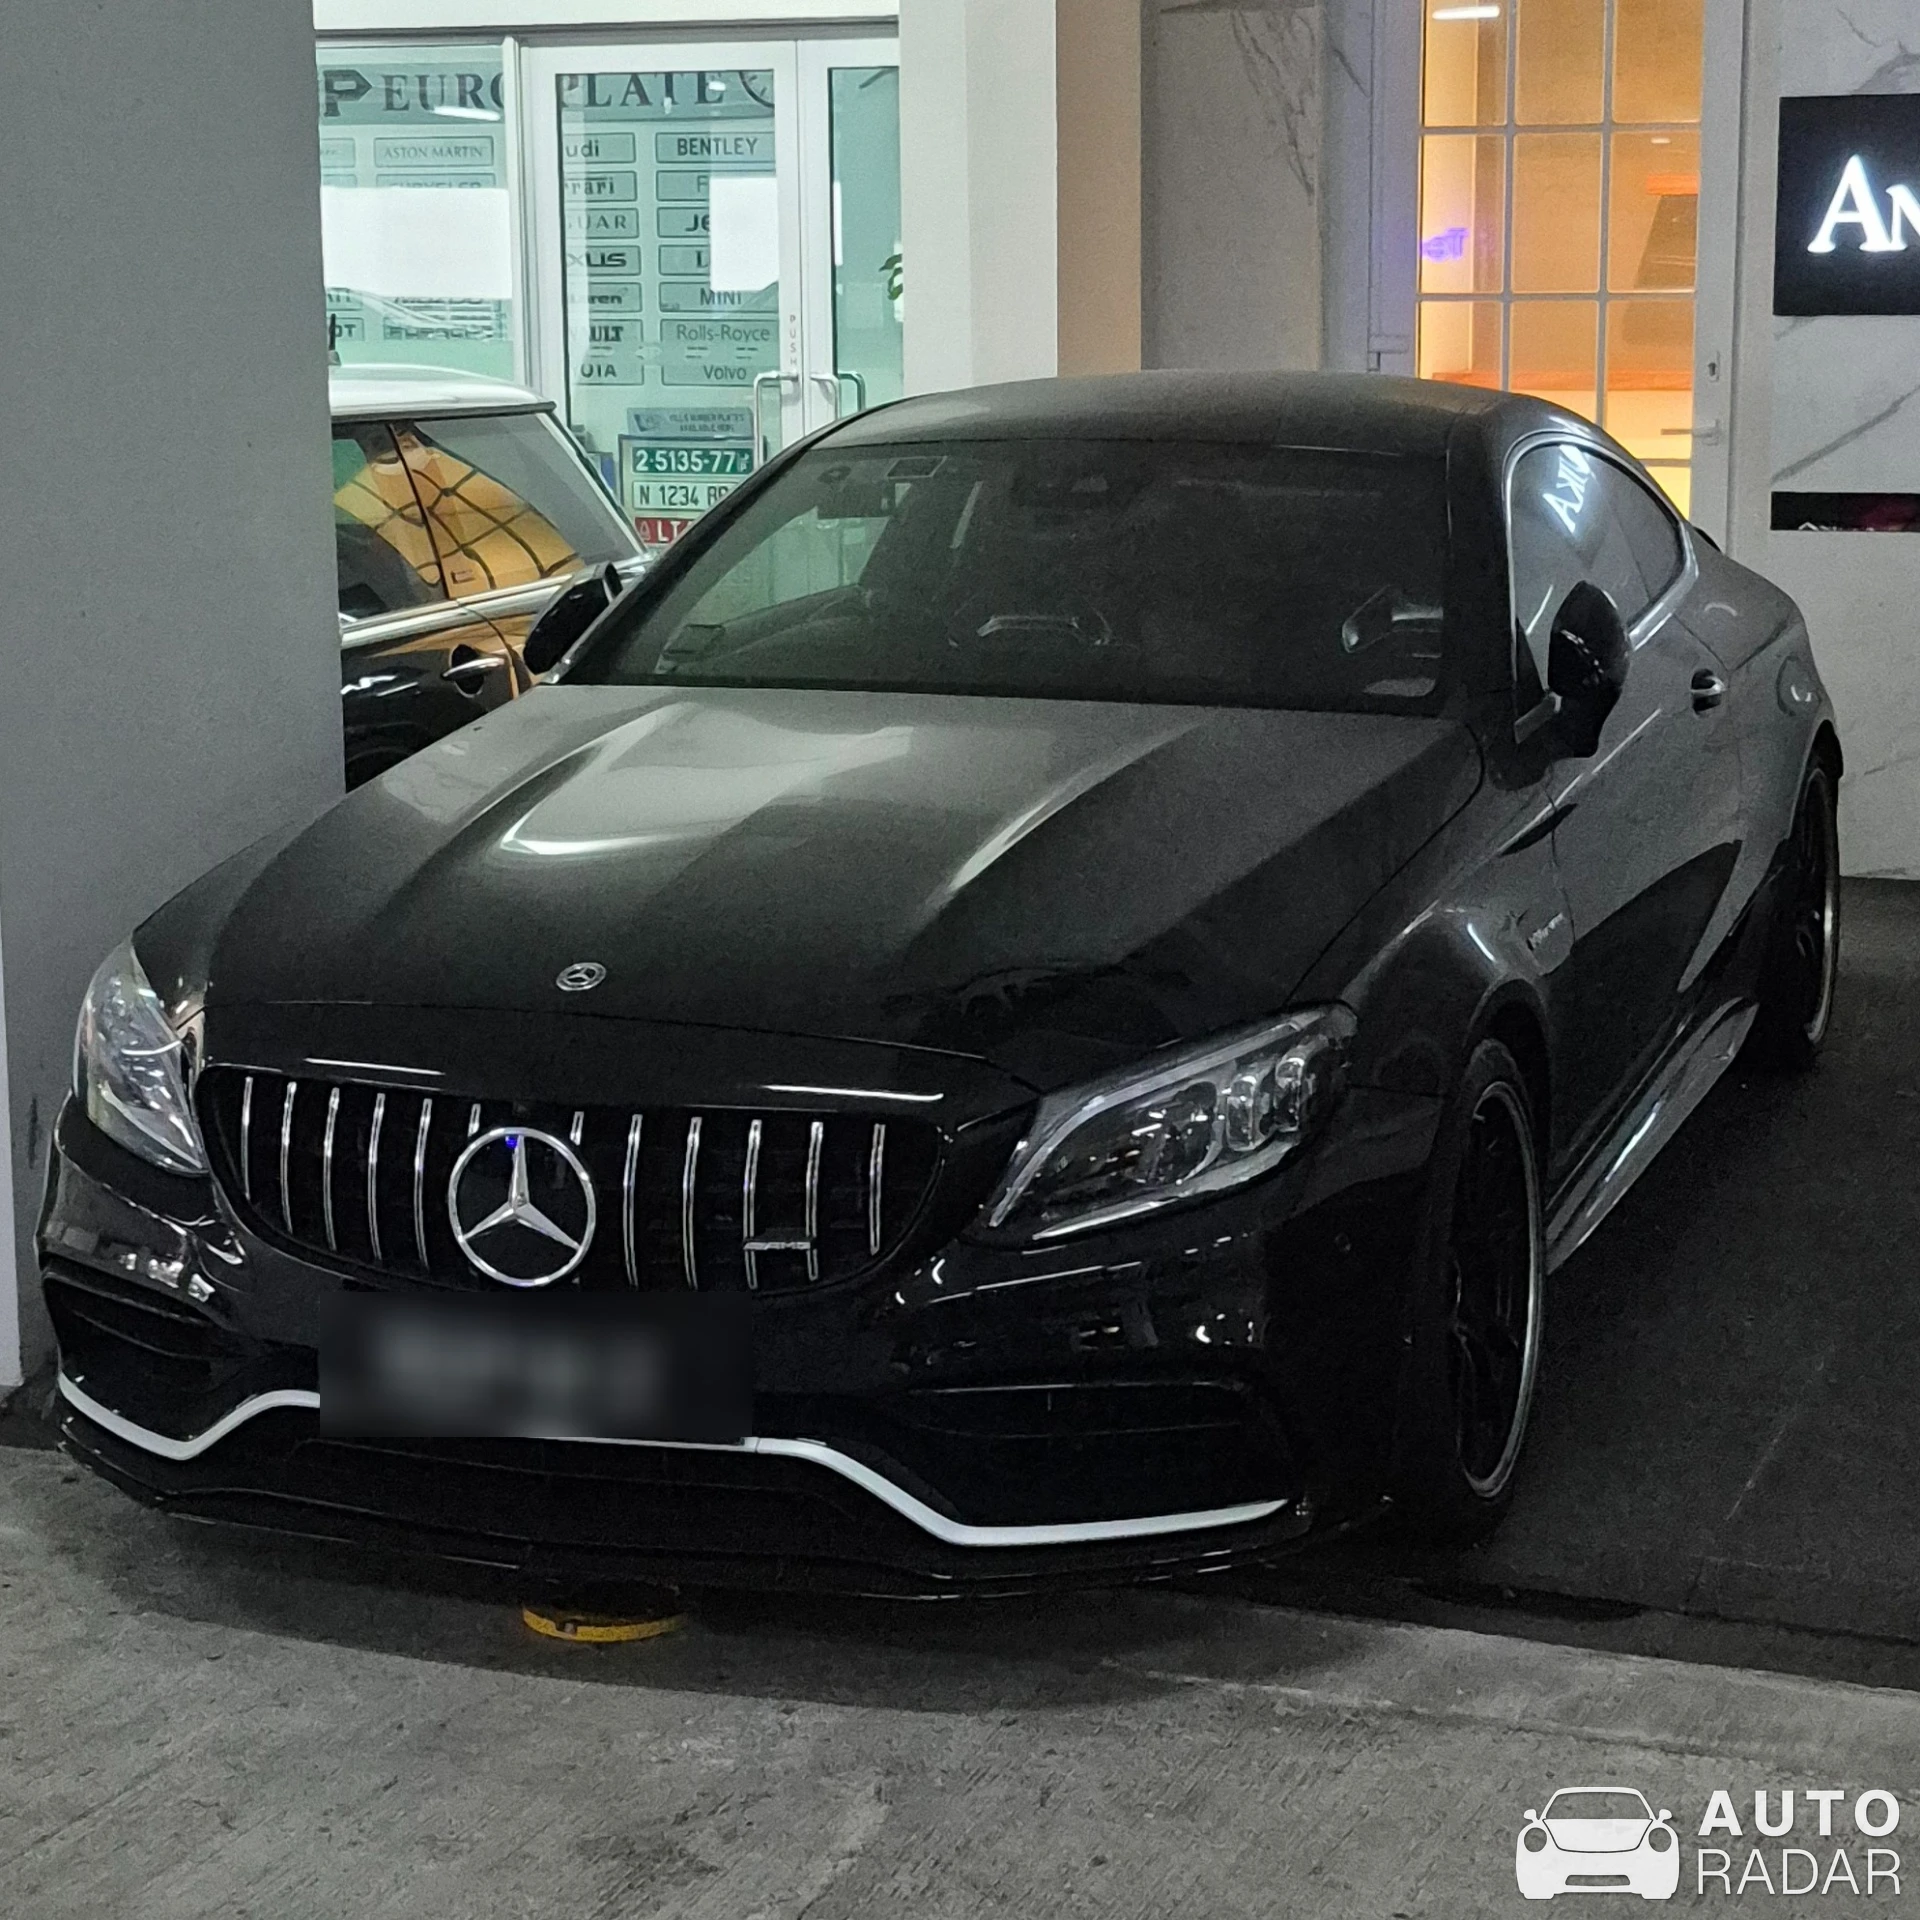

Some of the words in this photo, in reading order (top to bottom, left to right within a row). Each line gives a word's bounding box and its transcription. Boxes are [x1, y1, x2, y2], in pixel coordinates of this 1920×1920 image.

[385, 147, 427, 159] ASTON
[433, 145, 483, 158] MARTIN
[566, 139, 599, 157] udi
[677, 137, 759, 156] BENTLEY
[565, 176, 615, 195] rari
[569, 214, 627, 230] UAR
[568, 252, 627, 268] XUS
[700, 287, 742, 306] MINI
[589, 326, 624, 342] ULT
[677, 323, 771, 343] Rolls-Royce
[789, 314, 797, 365] PUSH
[703, 364, 748, 381] Volvo
[640, 485, 650, 505] N
[659, 485, 699, 506] 1234
[657, 520, 692, 542] LT
